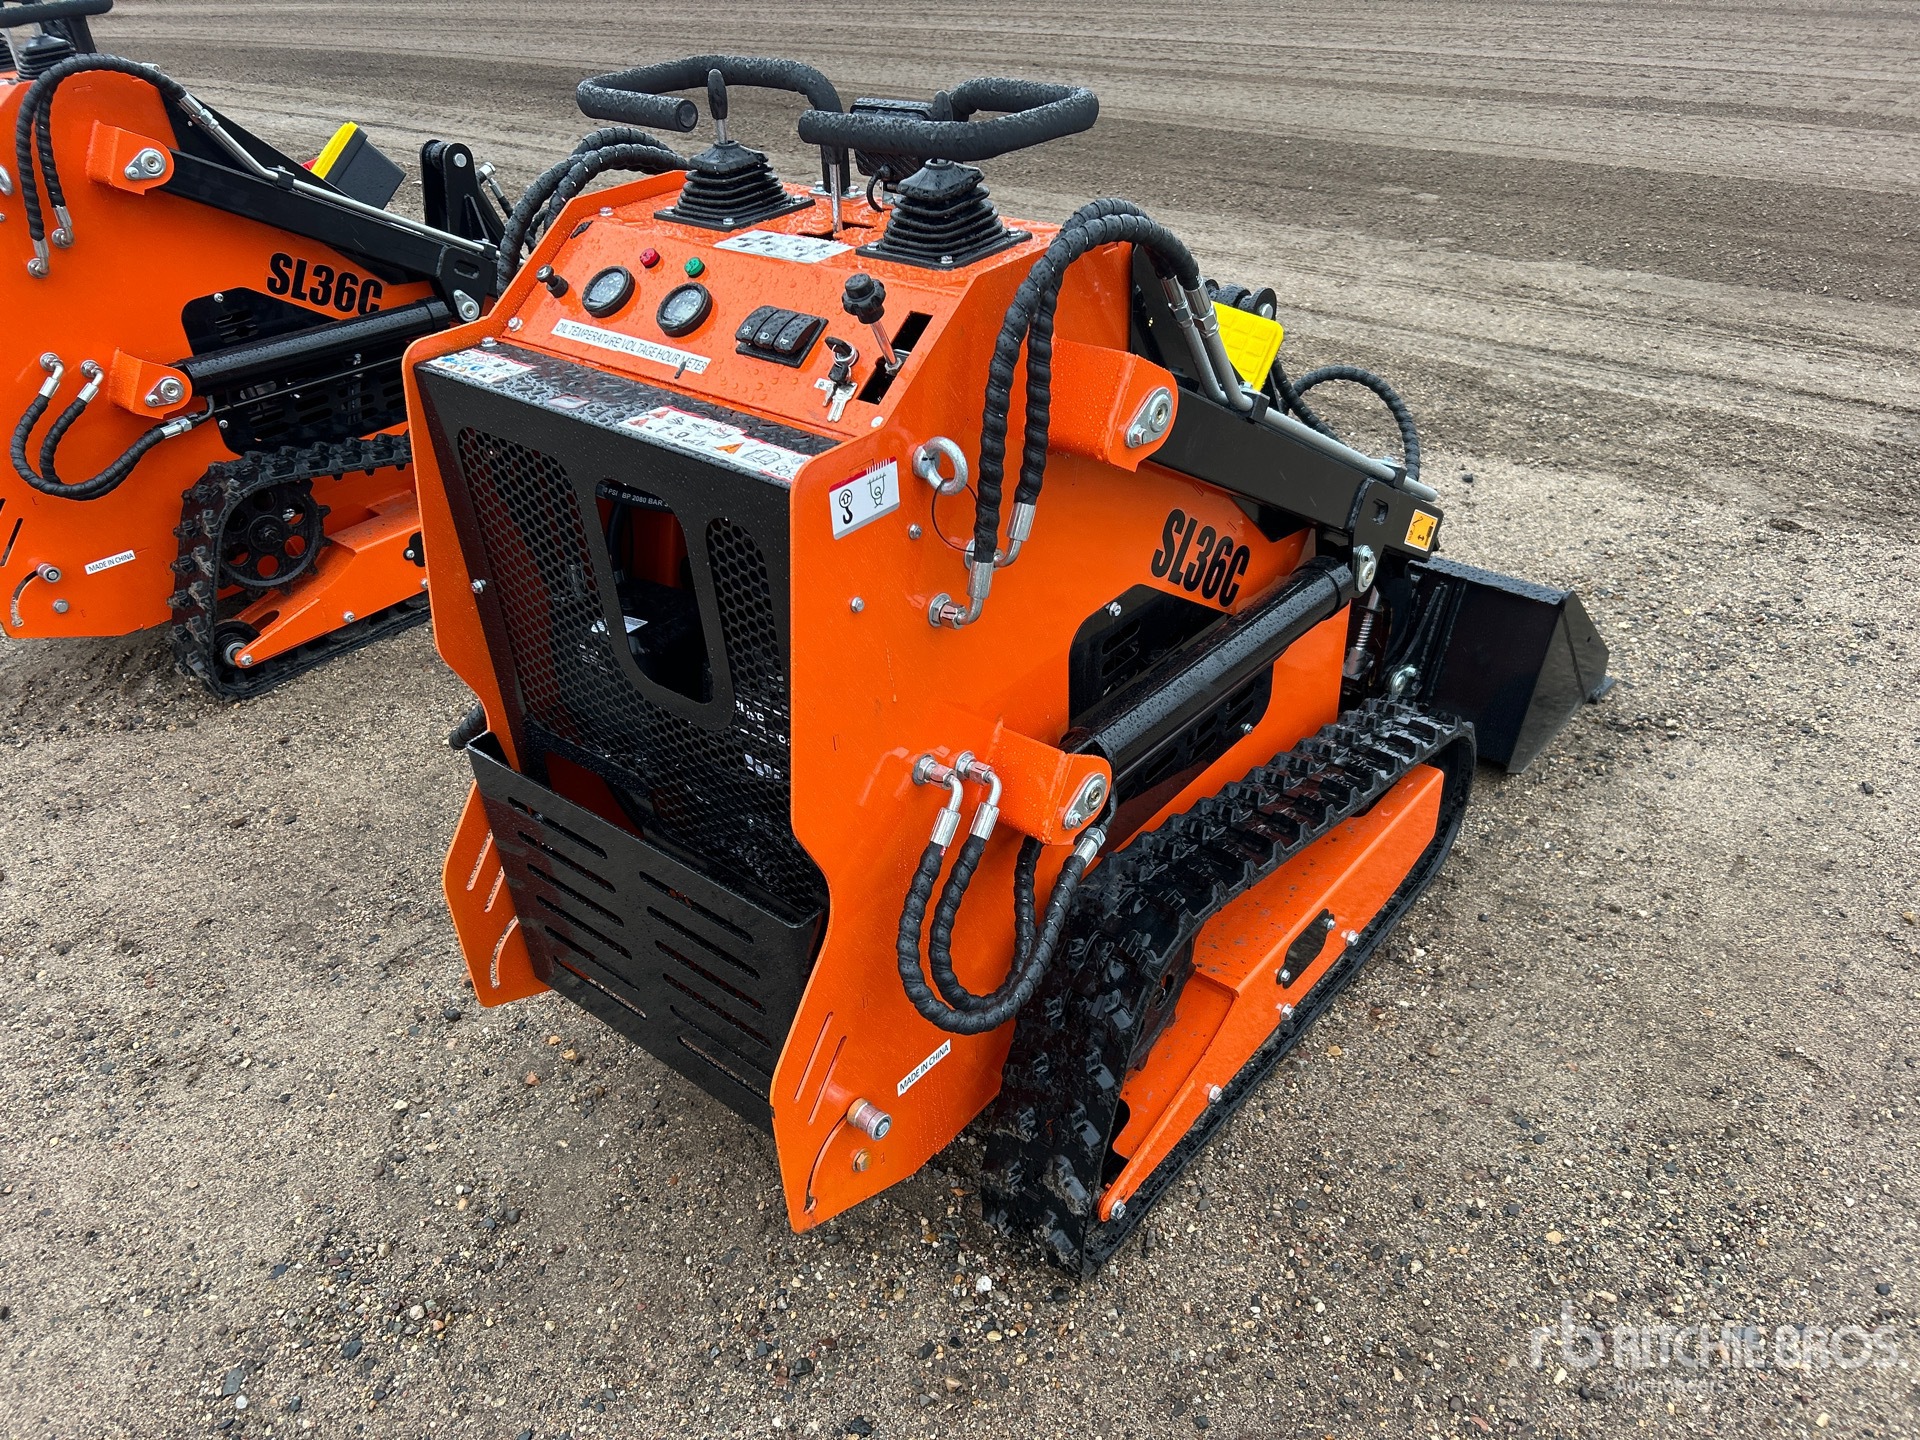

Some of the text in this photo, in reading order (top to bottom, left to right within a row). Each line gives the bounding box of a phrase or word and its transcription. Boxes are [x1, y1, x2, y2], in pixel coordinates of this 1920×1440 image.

[266, 251, 383, 316] SL36C
[555, 322, 708, 372] OIL TEMPERATURE VOLTAGE HOUR METER
[608, 488, 618, 496] PSI
[648, 498, 663, 506] BAR
[88, 561, 106, 572] MADE
[115, 553, 134, 563] CHINA
[1151, 508, 1250, 607] SL36C
[900, 1044, 949, 1091] MADE IN CHINA
